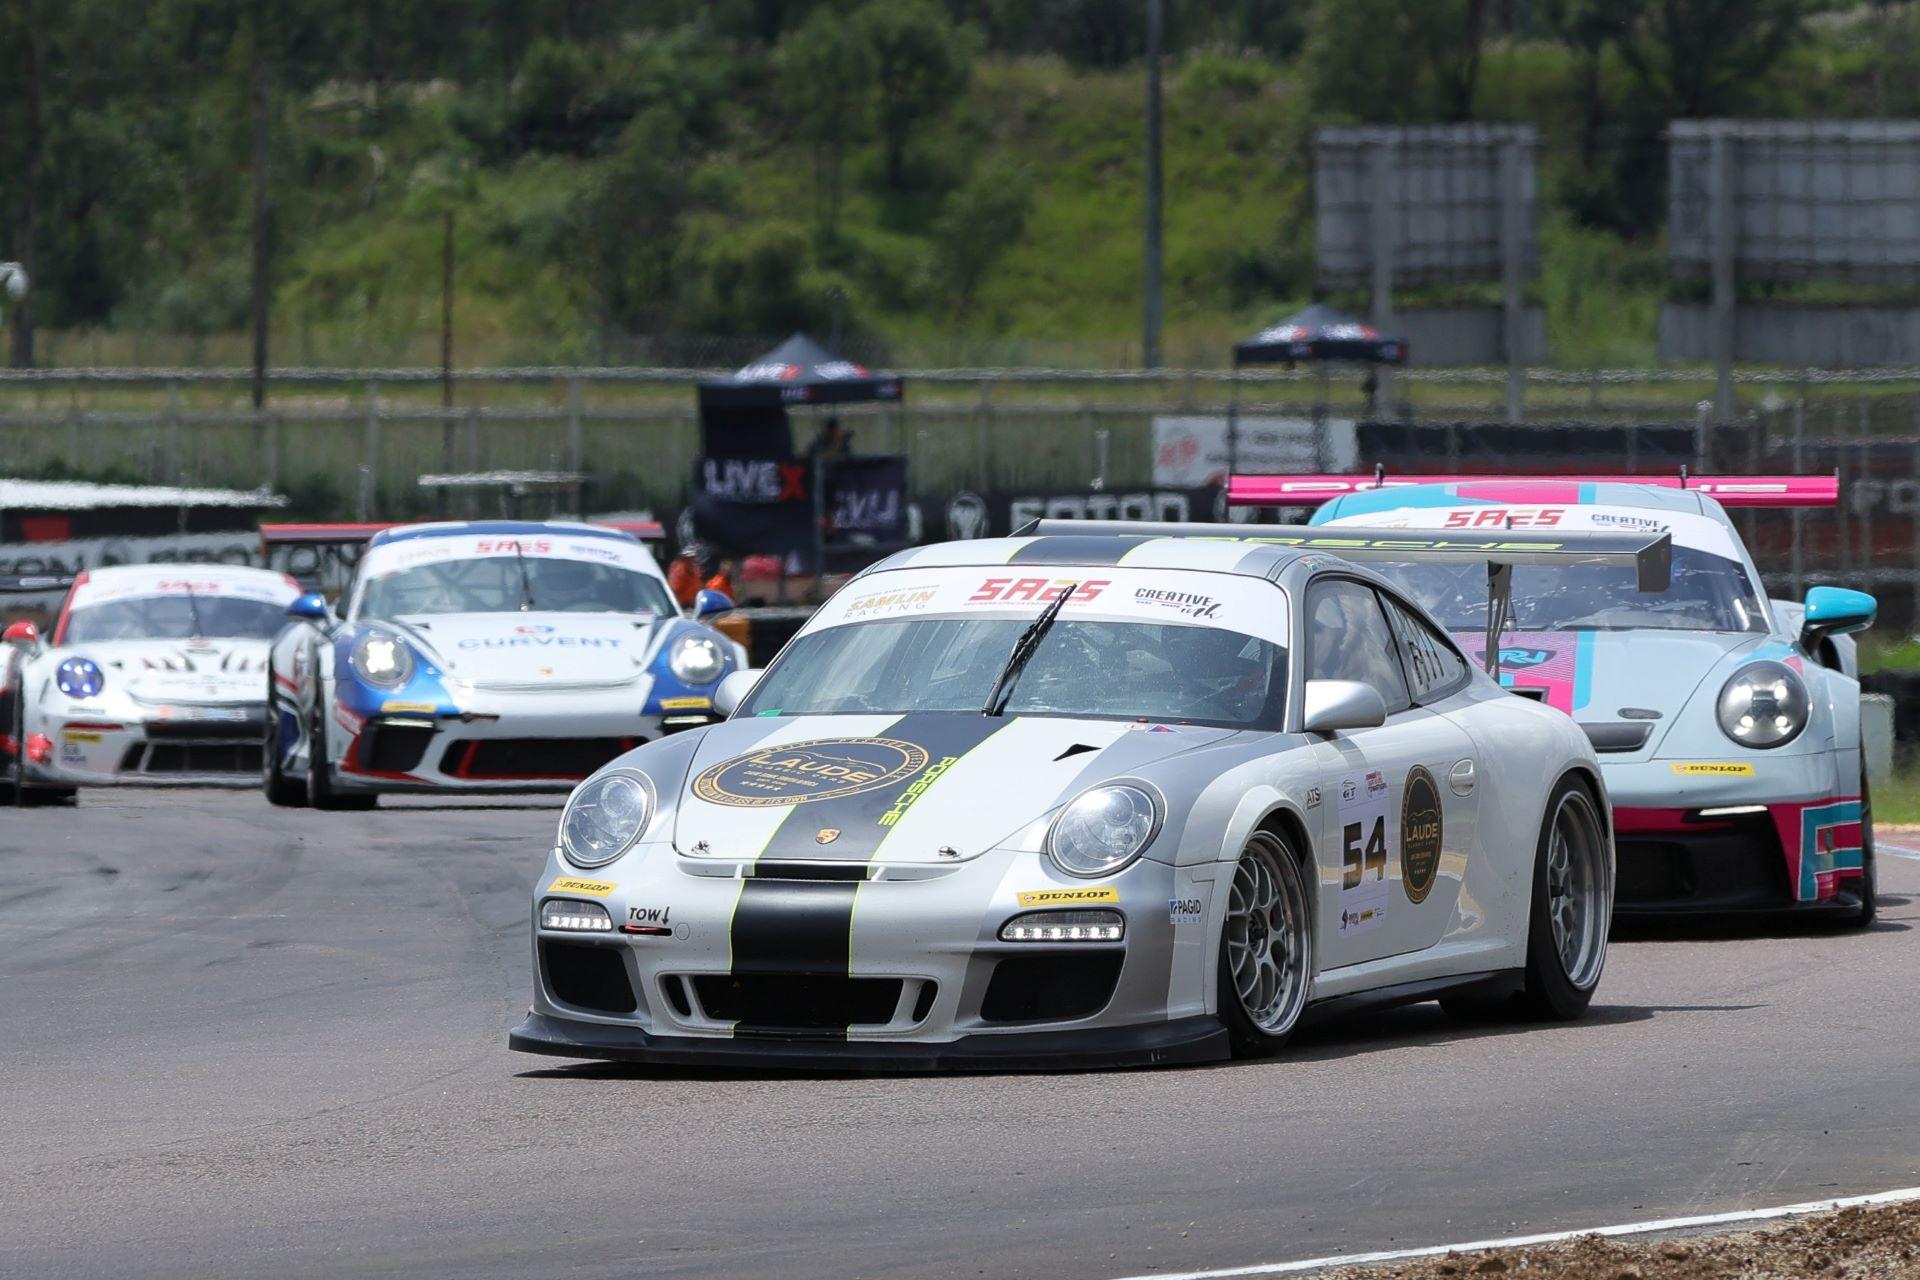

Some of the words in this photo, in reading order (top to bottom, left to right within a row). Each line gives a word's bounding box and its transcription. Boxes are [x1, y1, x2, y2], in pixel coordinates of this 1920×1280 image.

[1591, 513, 1661, 528] CREATIVE
[1134, 588, 1213, 607] CREATIVE
[750, 754, 878, 783] LAUDE
[1689, 765, 1747, 773] DUNLOP
[878, 756, 957, 826] PORSCHE
[1406, 822, 1438, 842] LAUDE
[1342, 815, 1387, 891] 54
[562, 881, 611, 892] DUNLOP
[1038, 891, 1110, 901] DUNLOP
[629, 907, 661, 921] TOW
[1177, 899, 1201, 915] PAGID
